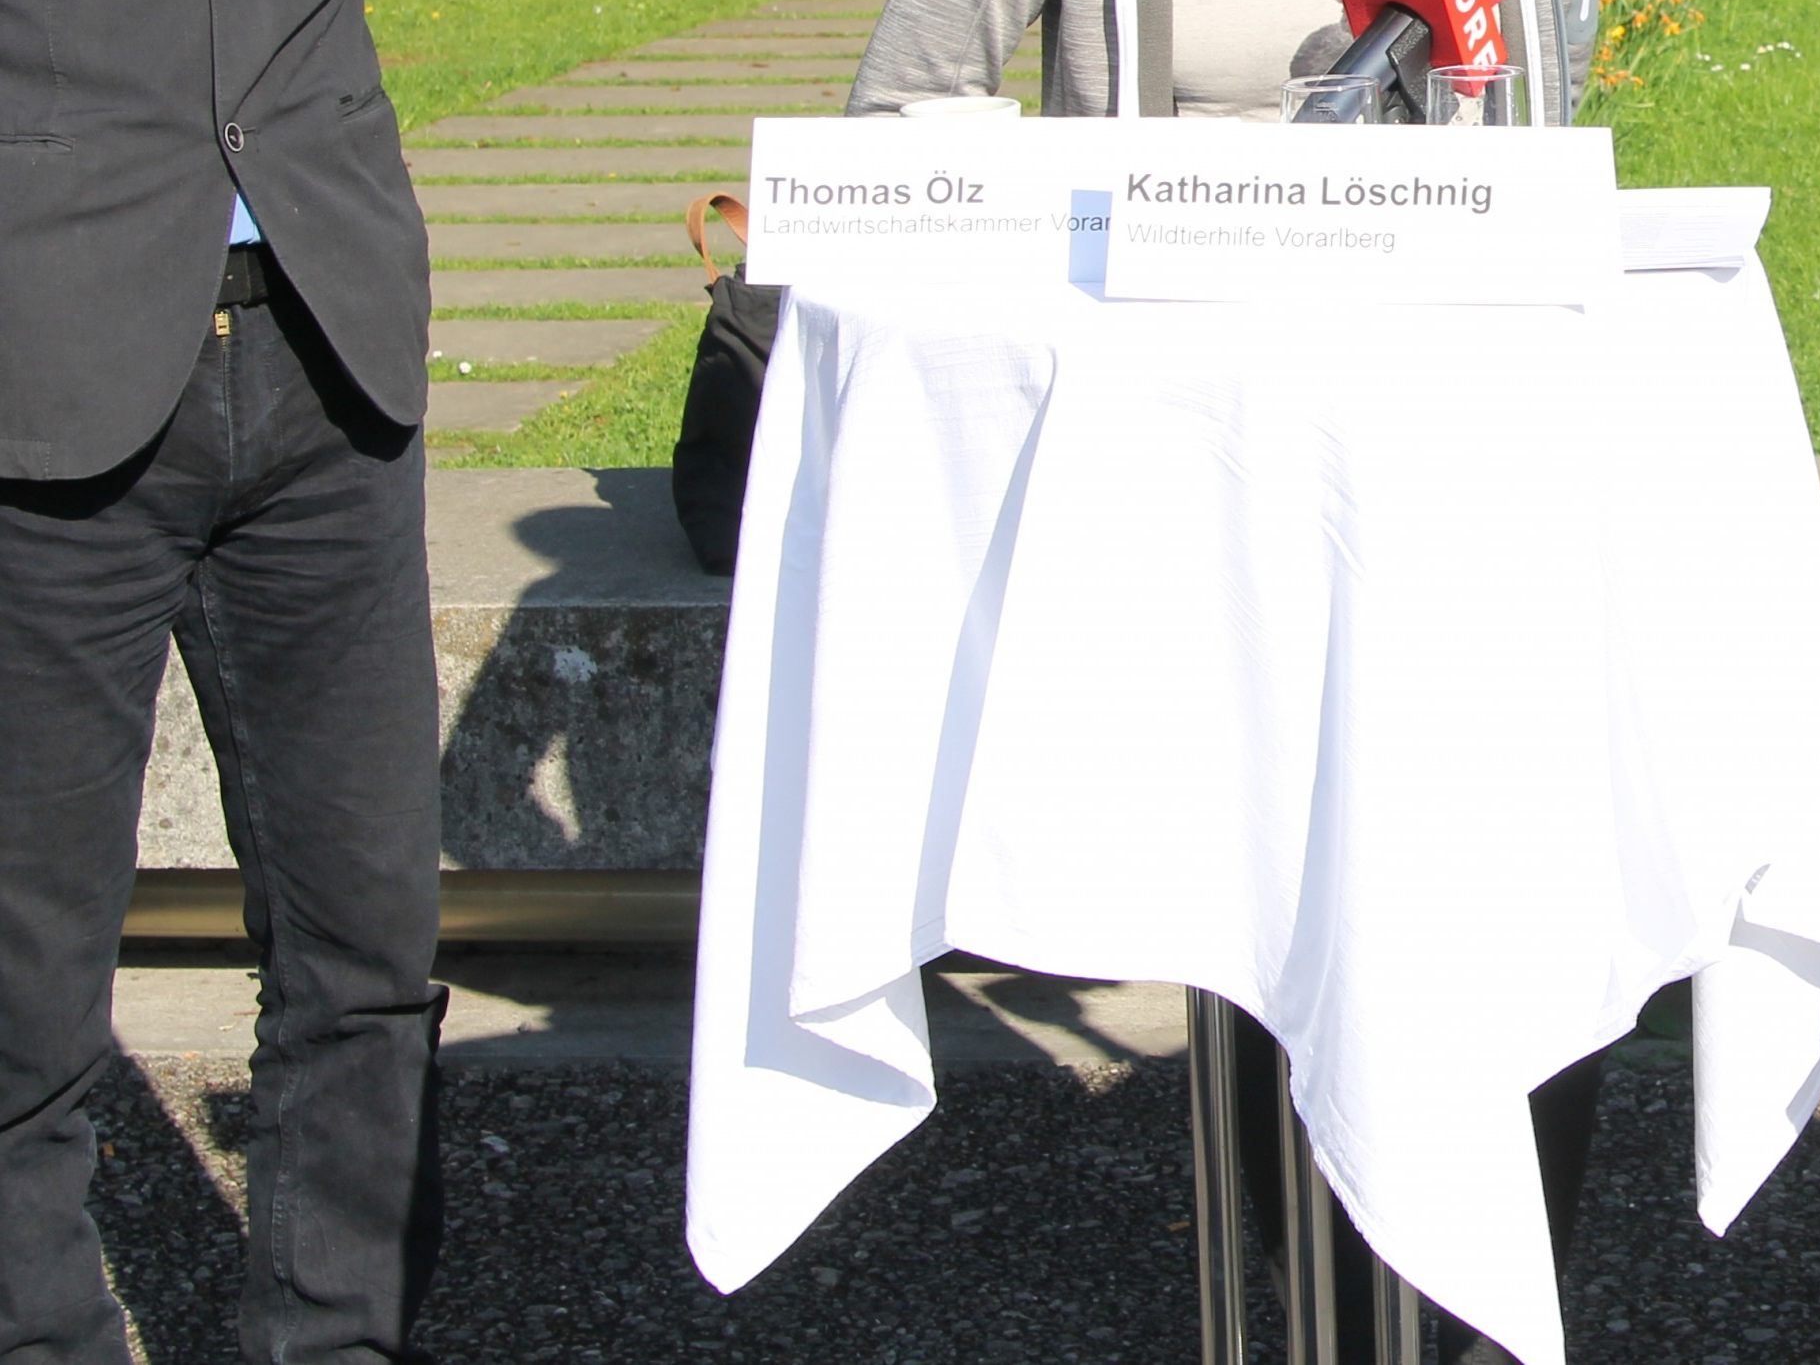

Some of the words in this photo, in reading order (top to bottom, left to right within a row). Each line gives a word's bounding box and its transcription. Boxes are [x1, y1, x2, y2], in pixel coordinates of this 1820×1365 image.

[764, 176, 912, 205] Thomas
[926, 170, 985, 204] Ölz
[1127, 173, 1306, 205] Katharina
[1321, 176, 1493, 215] Löschnig
[763, 213, 1042, 234] Landwirtschaftskammer
[1127, 223, 1265, 247] Wildtierhilfe
[1275, 227, 1396, 254] Vorarlberg
